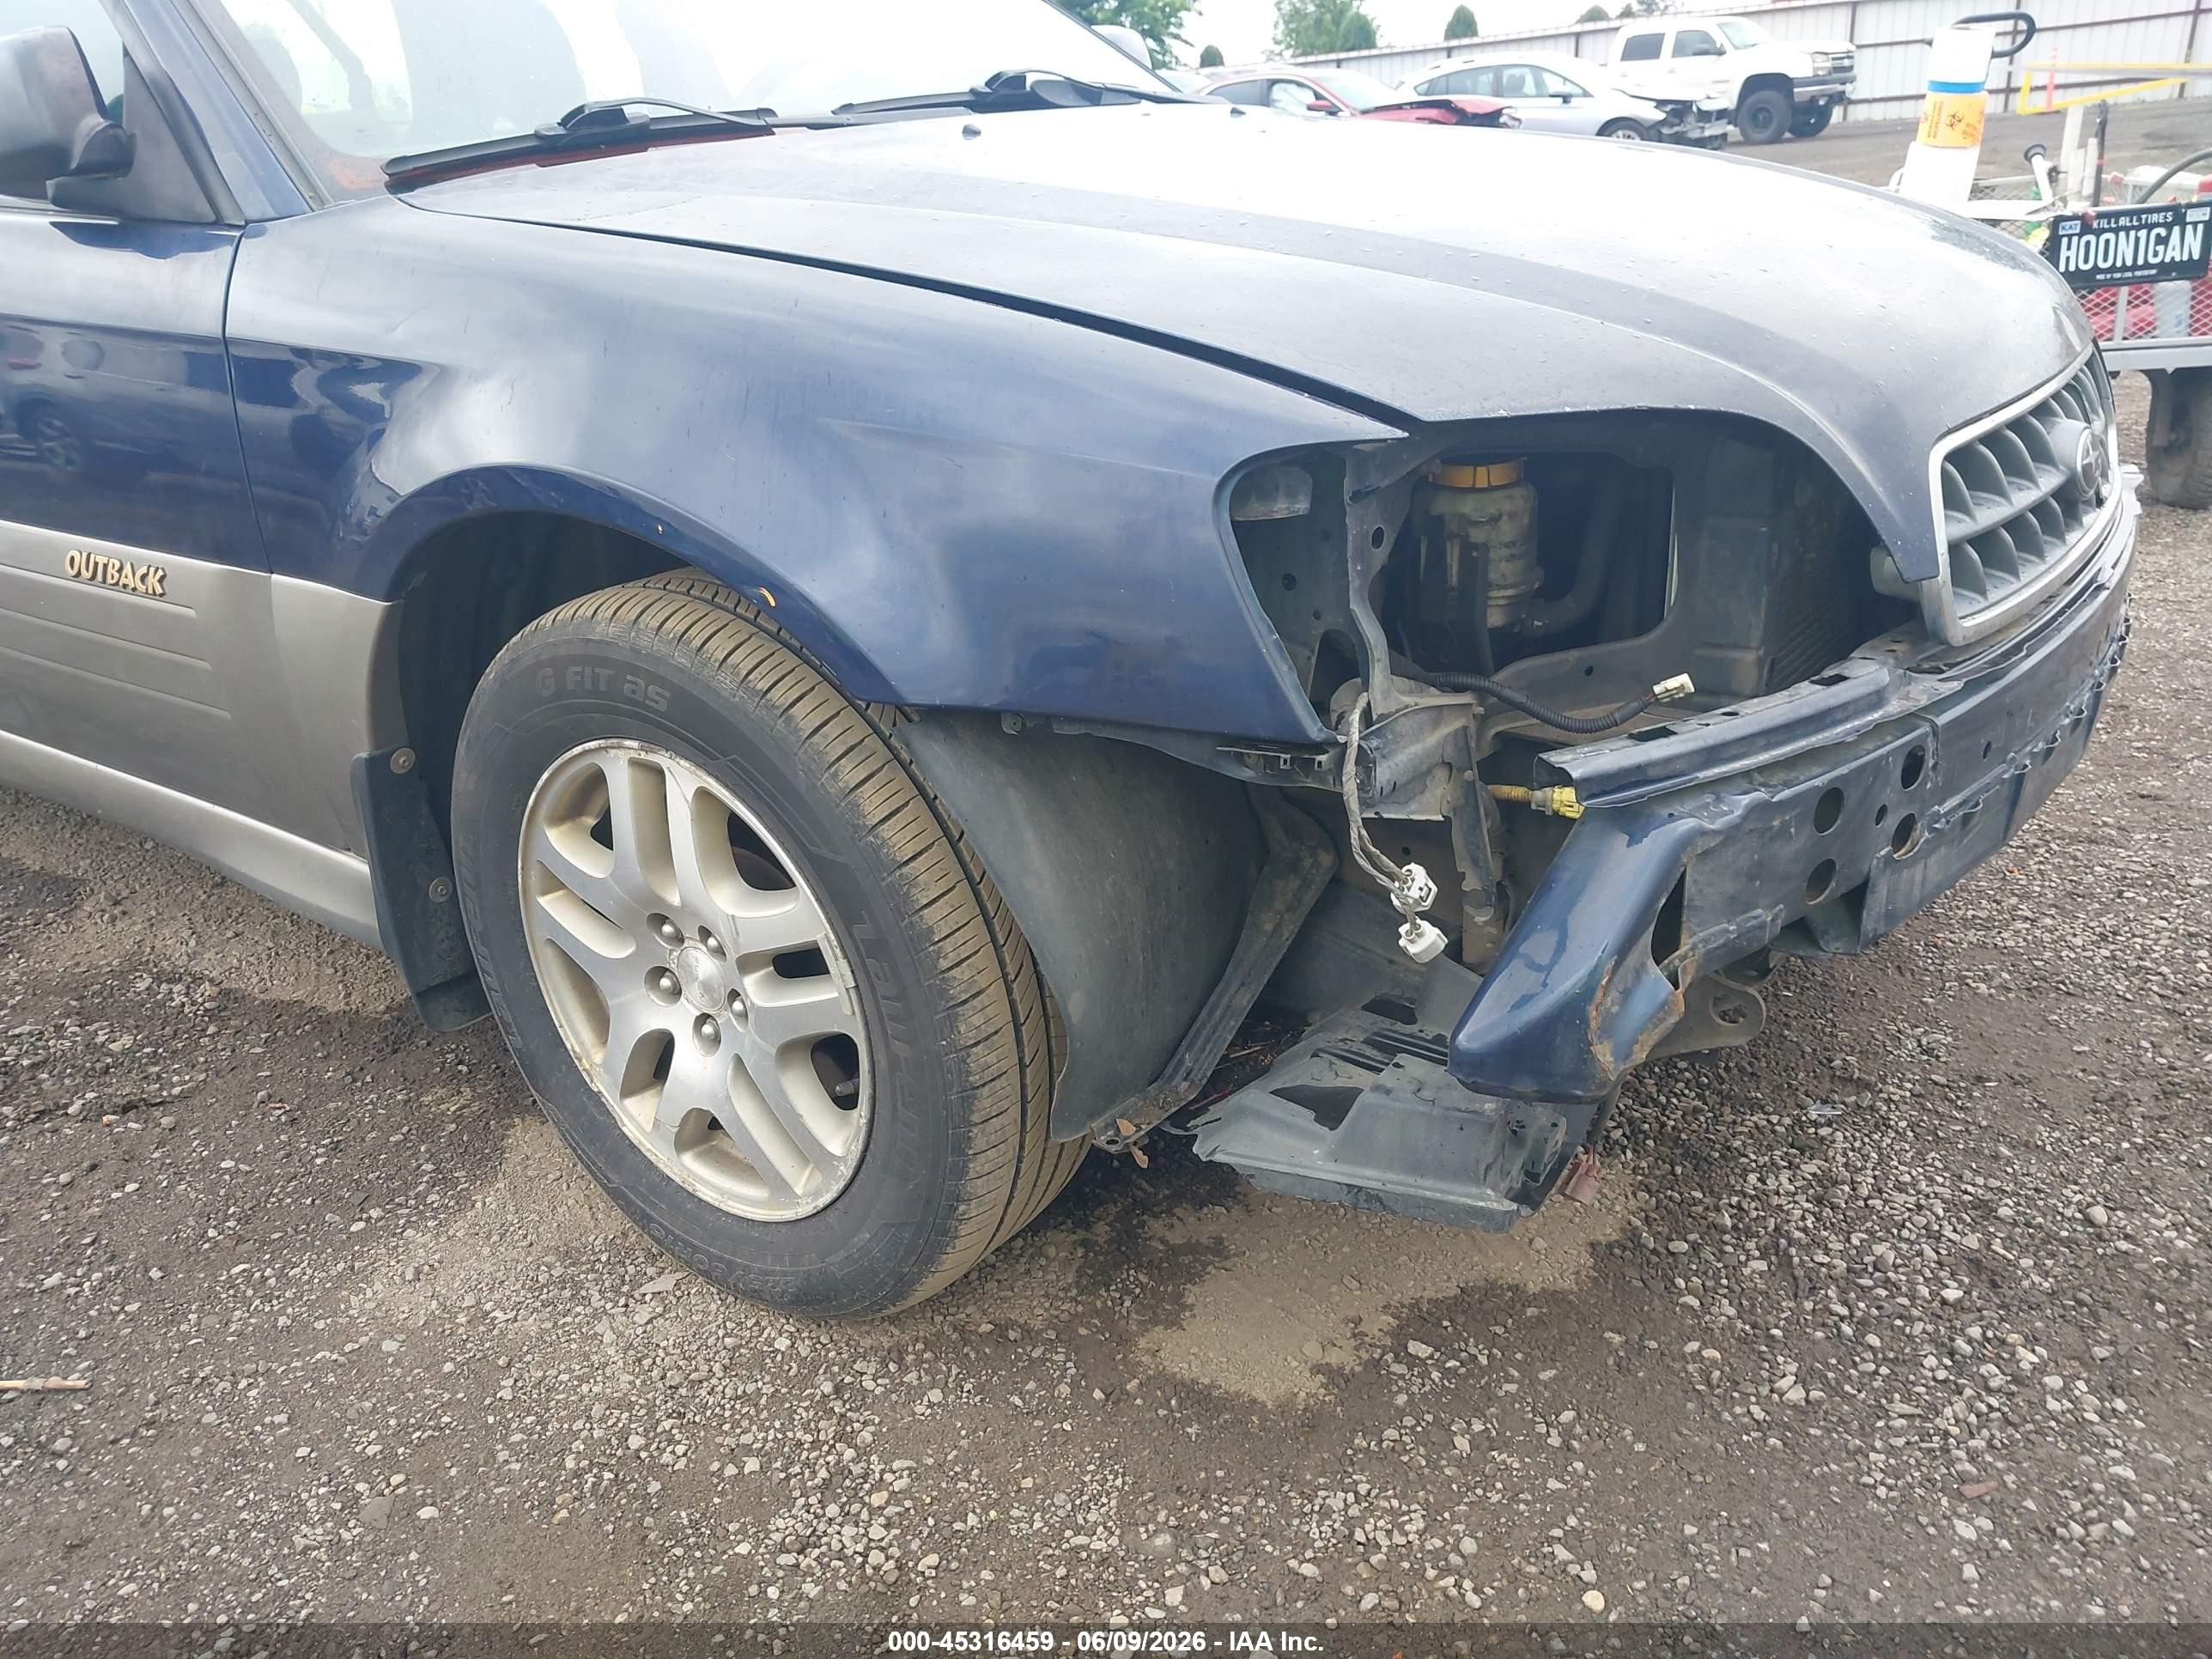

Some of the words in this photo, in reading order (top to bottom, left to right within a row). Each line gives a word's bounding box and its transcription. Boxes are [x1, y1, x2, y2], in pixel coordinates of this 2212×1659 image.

[65, 549, 167, 597] OUTBACK
[536, 667, 557, 697] G
[566, 665, 616, 692] FIT
